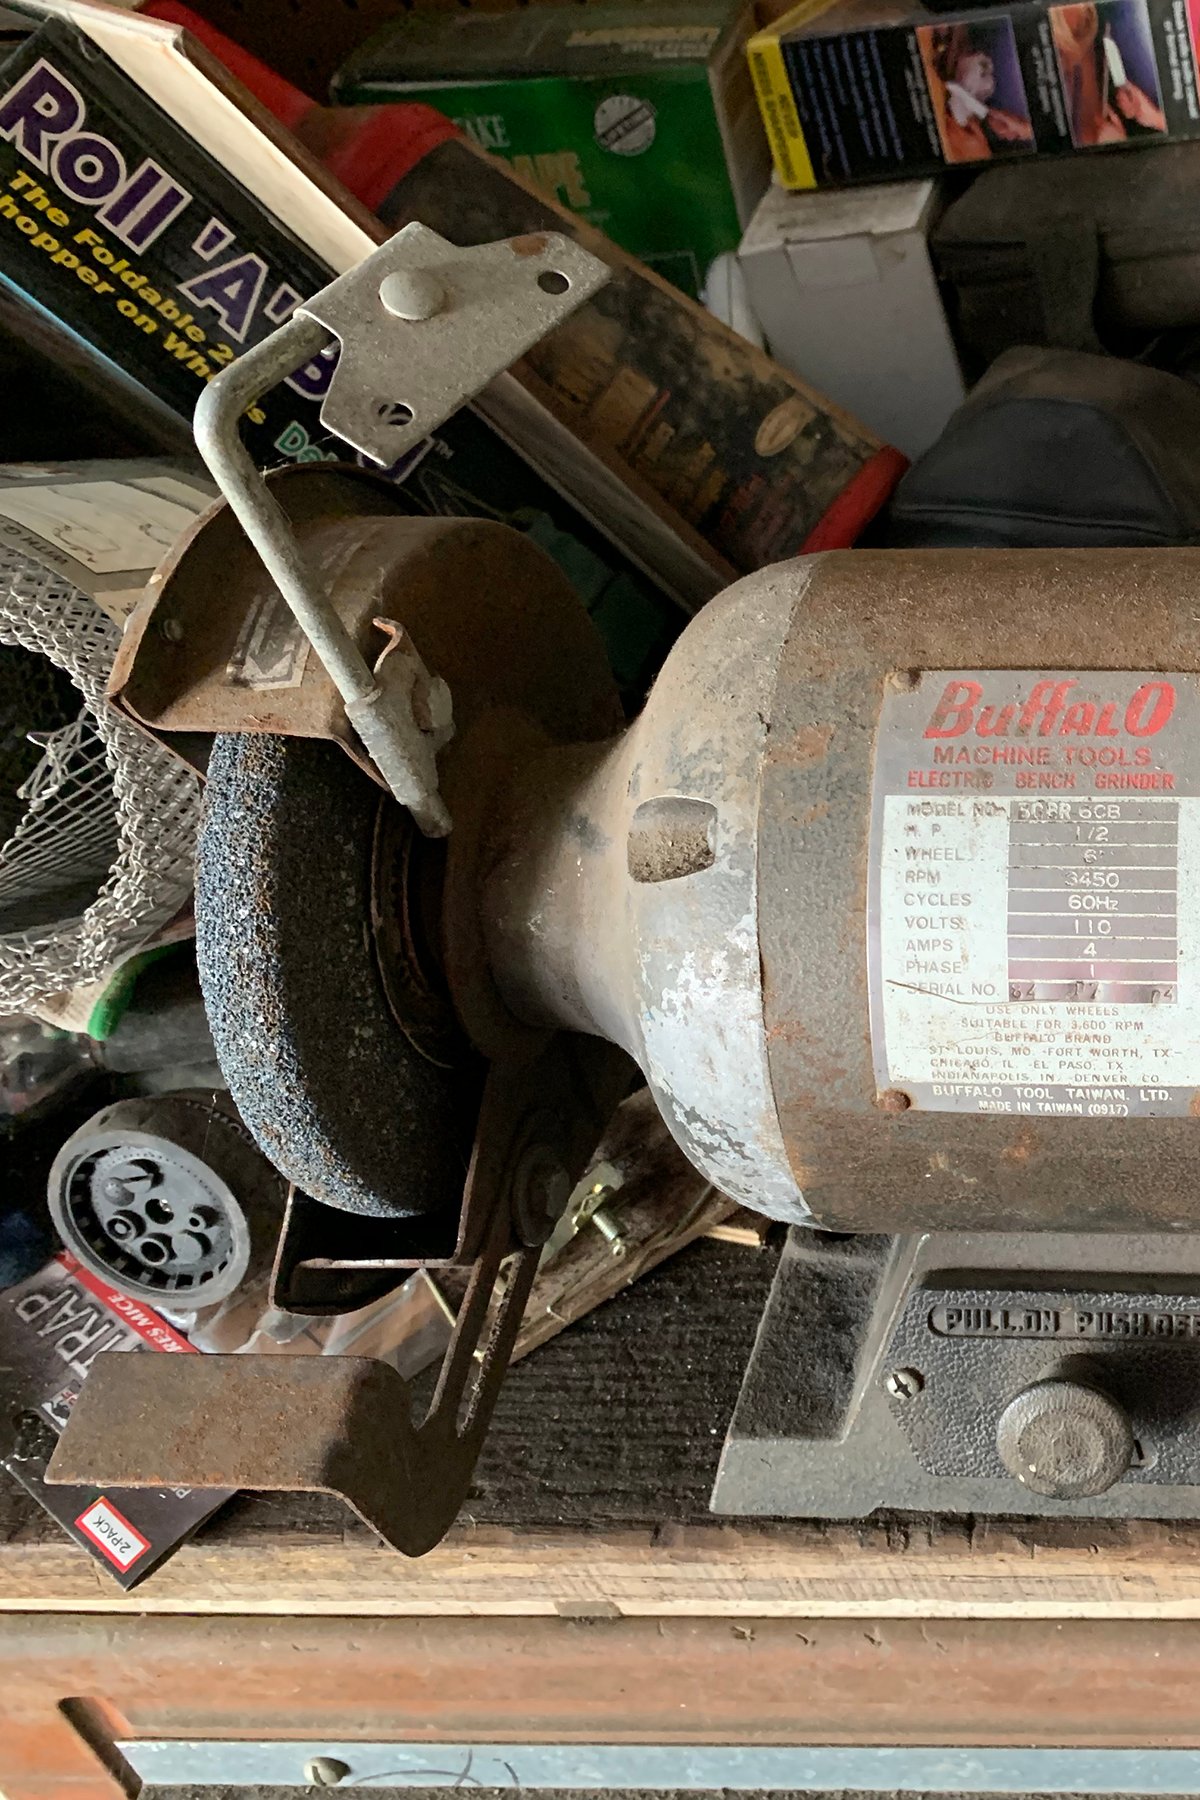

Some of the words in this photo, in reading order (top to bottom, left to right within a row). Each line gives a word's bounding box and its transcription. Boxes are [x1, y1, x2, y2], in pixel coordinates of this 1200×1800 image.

[0, 57, 194, 257] Roll
[0, 187, 116, 297] hopper
[117, 299, 158, 336] on
[8, 169, 71, 228] The
[73, 230, 207, 344] Foldable
[932, 745, 1051, 766] MACHINE
[1065, 746, 1153, 767] TOOLS
[907, 770, 993, 789] ELECTRIC
[1015, 771, 1077, 789] BENCH
[1094, 771, 1176, 791] GRINDER
[906, 803, 965, 818] MODEL
[904, 847, 964, 861] WHEEL
[904, 871, 941, 885] RPM
[1064, 871, 1120, 888] 3450
[903, 893, 972, 907] CYCLES
[1067, 895, 1119, 912] 60Hz
[904, 916, 961, 930] VOLTS
[1074, 919, 1112, 935] 110
[905, 939, 954, 952] AMPS
[1082, 942, 1097, 957] 4
[905, 961, 963, 975] PHASE
[1089, 963, 1096, 978] 1
[906, 982, 965, 997] SERIAL
[971, 983, 1000, 997] NO.
[985, 1005, 1011, 1015] USE
[1021, 1006, 1057, 1016] ONLY
[1065, 1006, 1120, 1017] WHEELS
[960, 1019, 1028, 1030] SUITABLE
[1035, 1019, 1062, 1030] FOR
[1115, 1020, 1144, 1031] RPM
[994, 1032, 1056, 1043] BUFFALO
[1064, 1033, 1112, 1044] BRAND
[932, 1084, 1002, 1098] BUFFALO
[1013, 1087, 1054, 1100] TOOL
[1139, 1089, 1173, 1102] LTD.
[978, 1100, 1012, 1113] MADE
[1017, 1101, 1032, 1113] IN
[1035, 1101, 1084, 1115] TAIWAN
[1087, 1102, 1129, 1117] (0917)
[107, 1293, 155, 1330] MICE
[92, 1514, 132, 1555] 2-PACK
